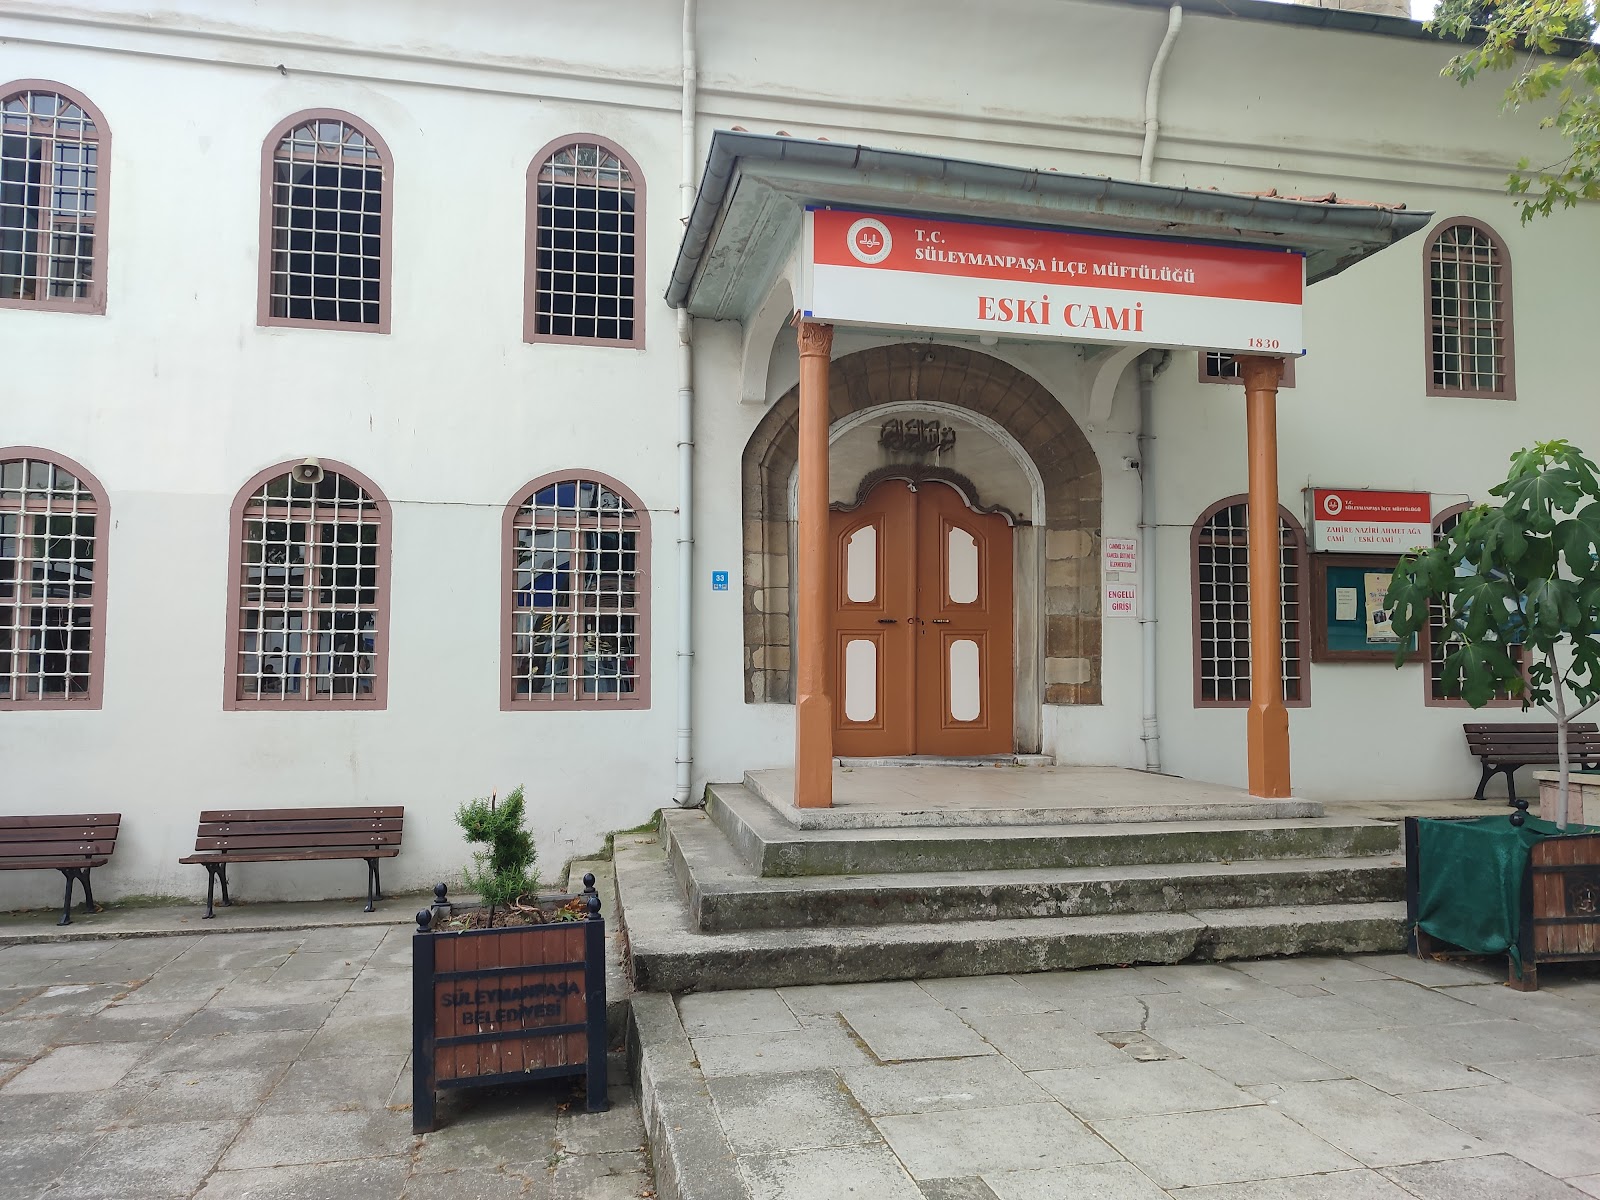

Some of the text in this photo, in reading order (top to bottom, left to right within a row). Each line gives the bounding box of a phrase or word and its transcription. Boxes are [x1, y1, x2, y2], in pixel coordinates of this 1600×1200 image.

[914, 229, 946, 244] T.C.
[915, 246, 1196, 283] SÜLEYMANPAŞA İLÇE MÜFTÜLÜĞÜ
[977, 294, 1144, 332] ESKİ CAMİ
[1248, 338, 1280, 349] 1830
[1326, 526, 1421, 535] ZAHİRE NAZİRİ AHMET AĞA
[1108, 590, 1135, 599] ENGELLİ
[1111, 602, 1132, 612] GİRİŞİ
[441, 981, 580, 1008] SÜLEYMANPAŞA
[462, 1002, 562, 1026] BELEDİYESİ
